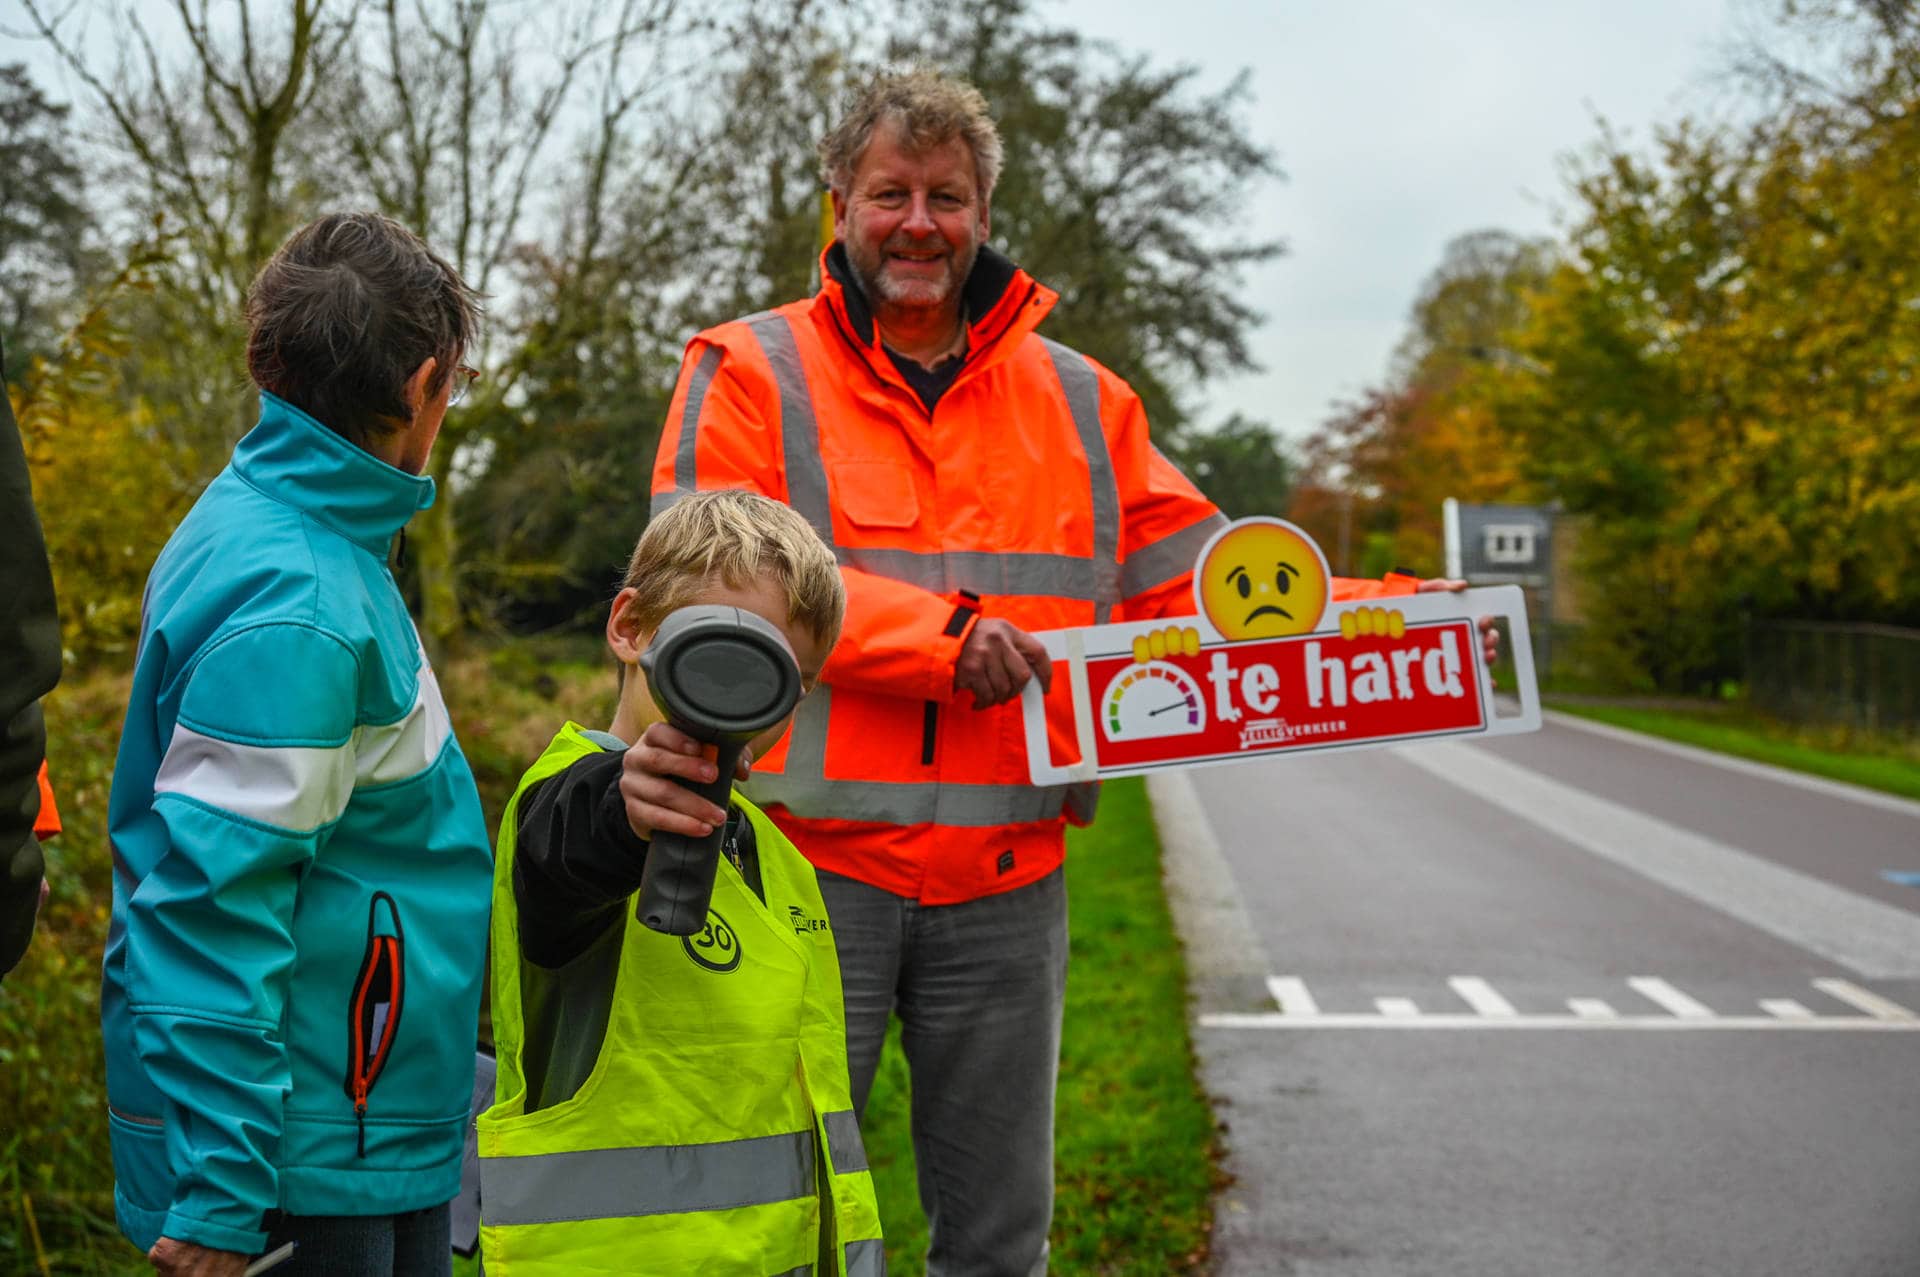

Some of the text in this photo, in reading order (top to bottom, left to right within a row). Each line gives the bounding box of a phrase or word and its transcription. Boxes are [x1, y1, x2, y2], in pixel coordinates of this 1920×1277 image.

[1206, 630, 1465, 722] te hard
[696, 921, 732, 951] 30
